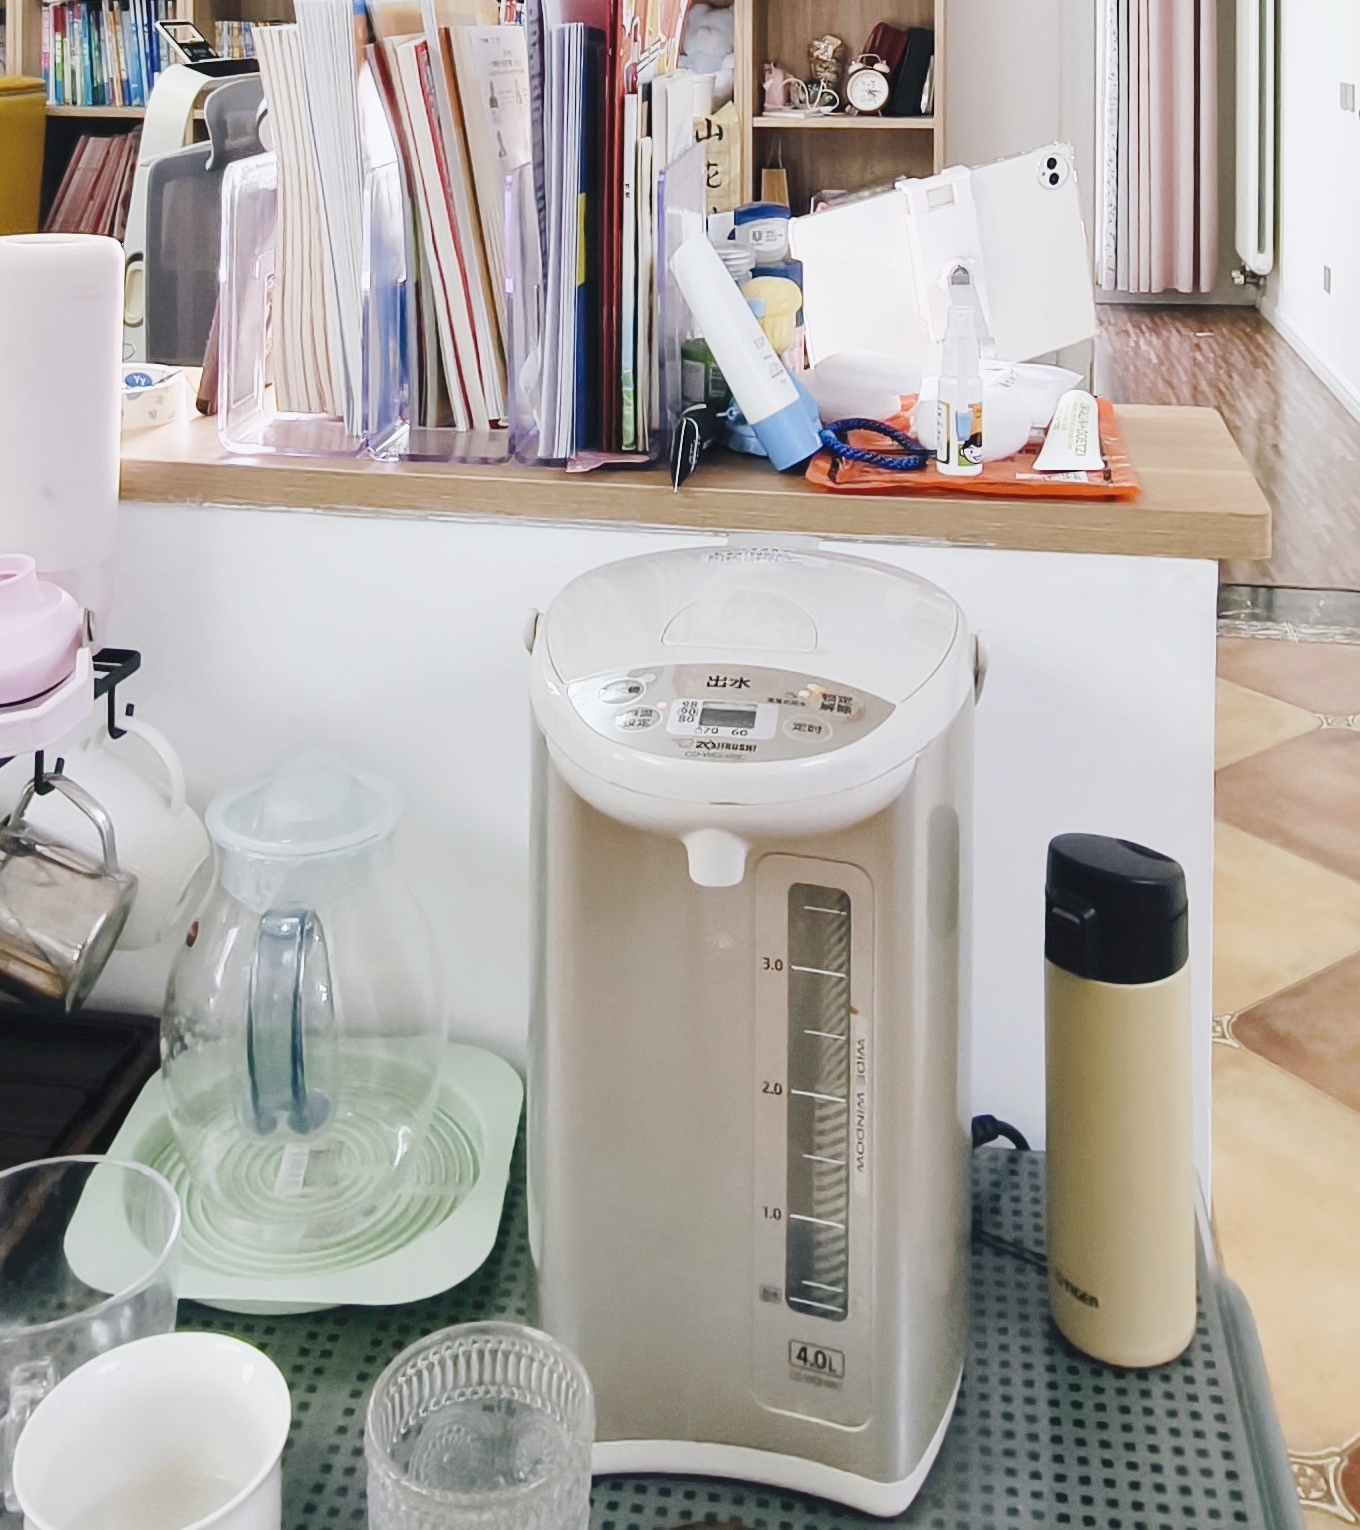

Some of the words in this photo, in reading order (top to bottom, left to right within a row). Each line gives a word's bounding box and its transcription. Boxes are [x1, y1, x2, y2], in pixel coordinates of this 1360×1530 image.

[706, 675, 751, 690] 出水
[704, 727, 719, 735] 70
[731, 728, 749, 736] 60
[696, 739, 758, 753] ZOJIRUSHI
[762, 957, 783, 972] 3.0
[855, 1038, 866, 1087] WIDE
[761, 1081, 783, 1096] 2.0
[855, 1092, 866, 1173] WINDOW
[762, 1206, 782, 1222] 1.0
[795, 1344, 837, 1376] 4.0L
